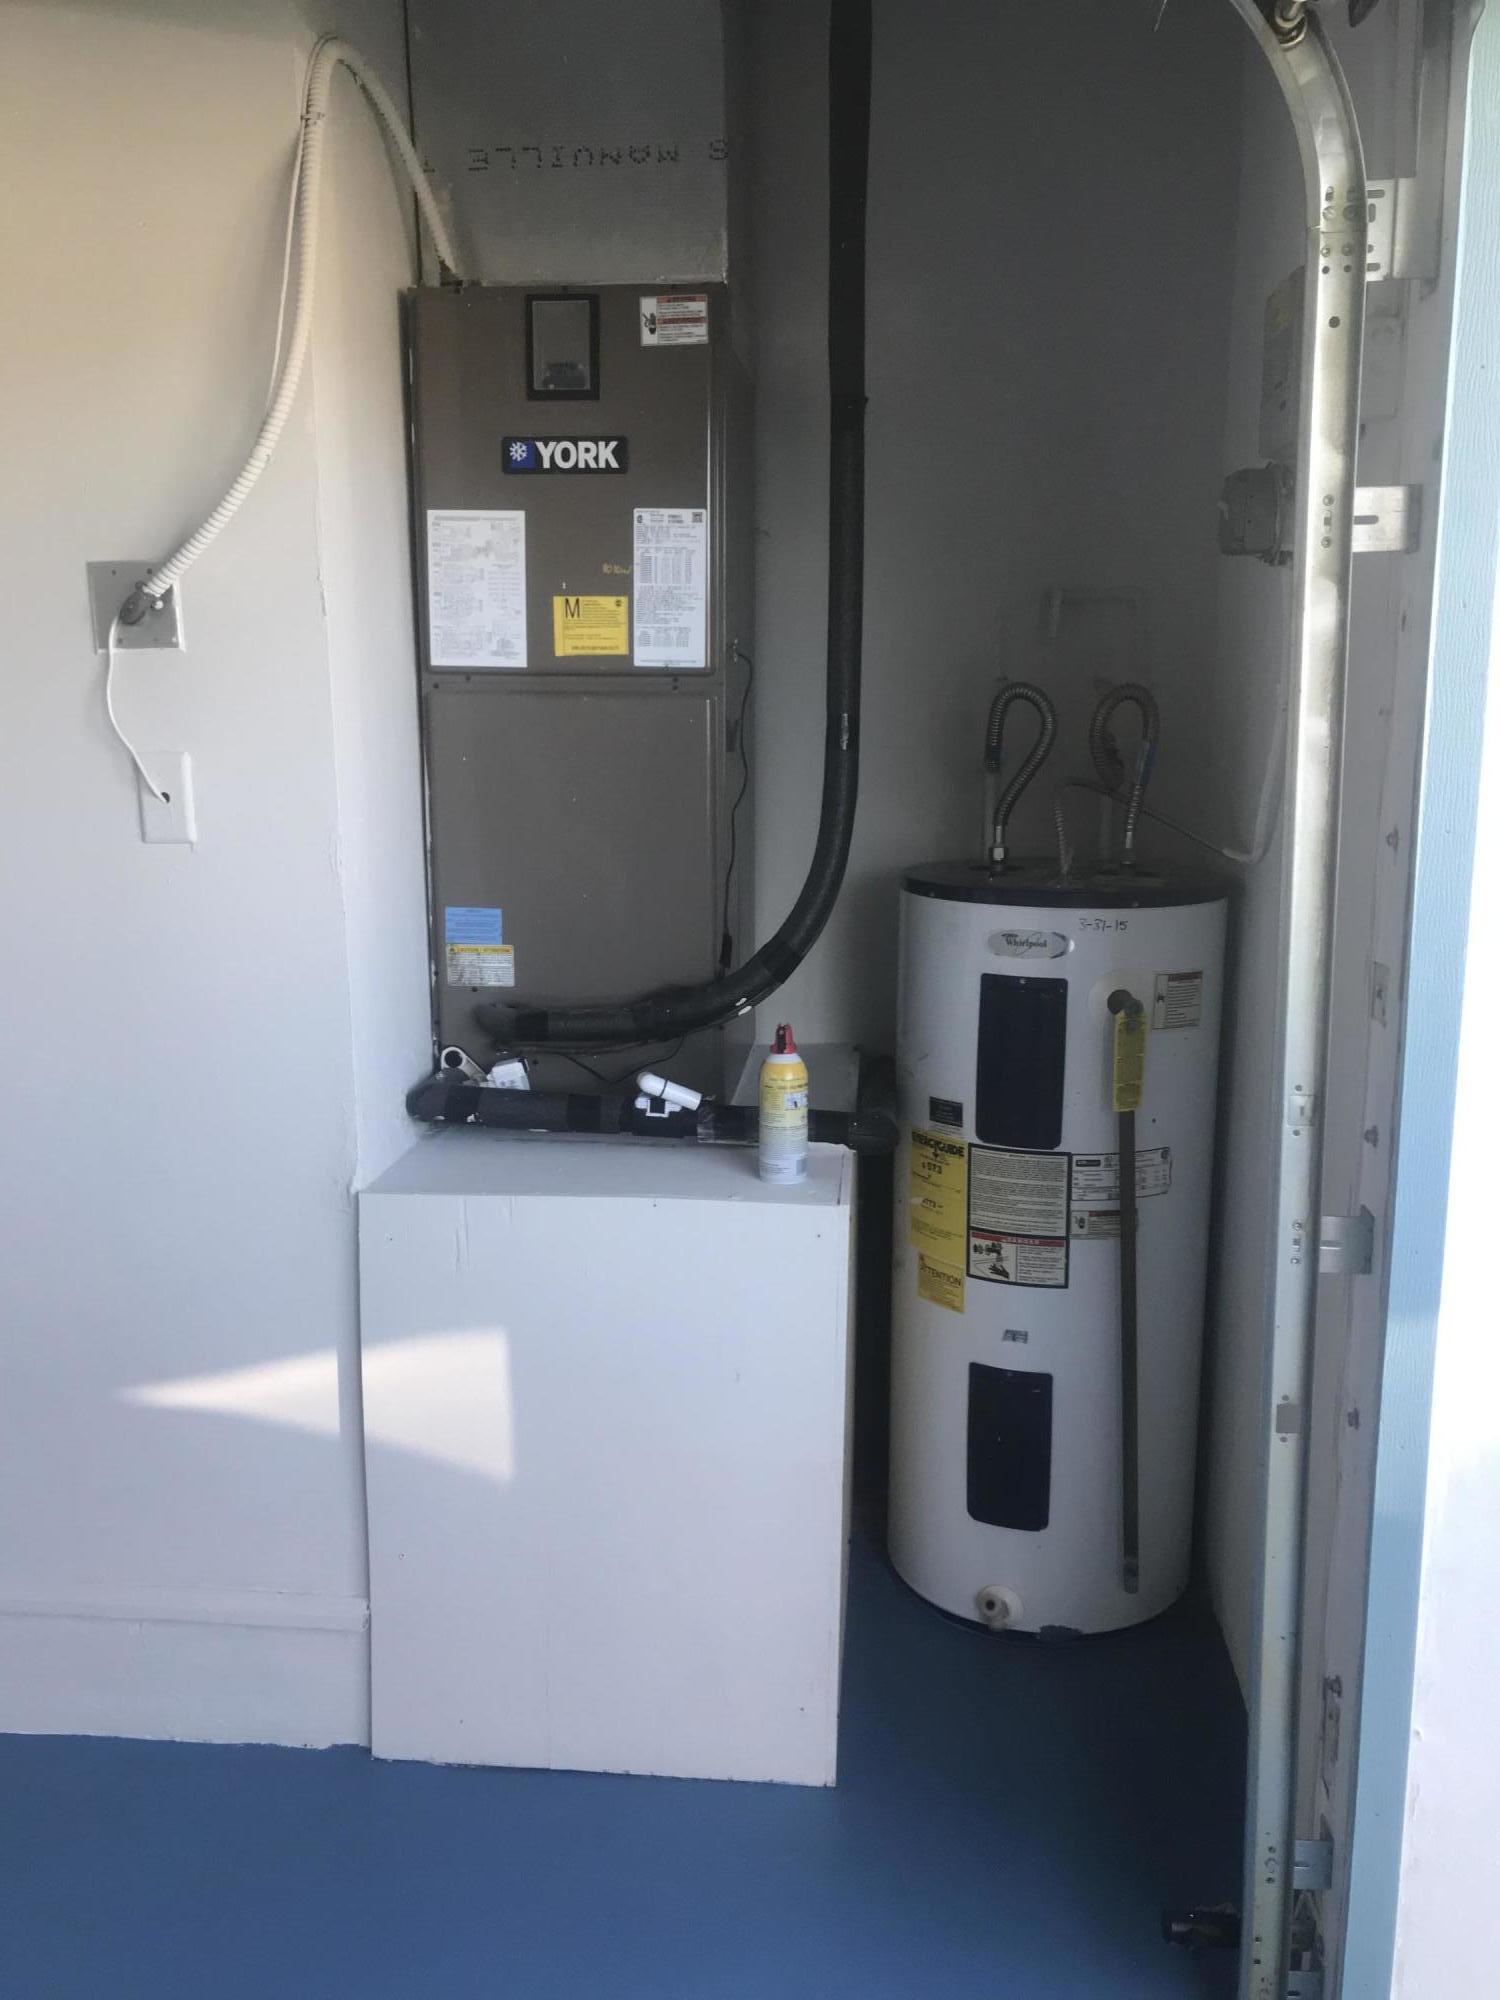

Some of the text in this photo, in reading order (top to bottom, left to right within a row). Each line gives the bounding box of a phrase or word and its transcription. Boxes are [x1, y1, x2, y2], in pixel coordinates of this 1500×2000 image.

[468, 145, 680, 170] MANVILLE
[534, 440, 620, 469] YORK
[565, 597, 581, 619] M
[1001, 932, 1047, 949] Whirlpool
